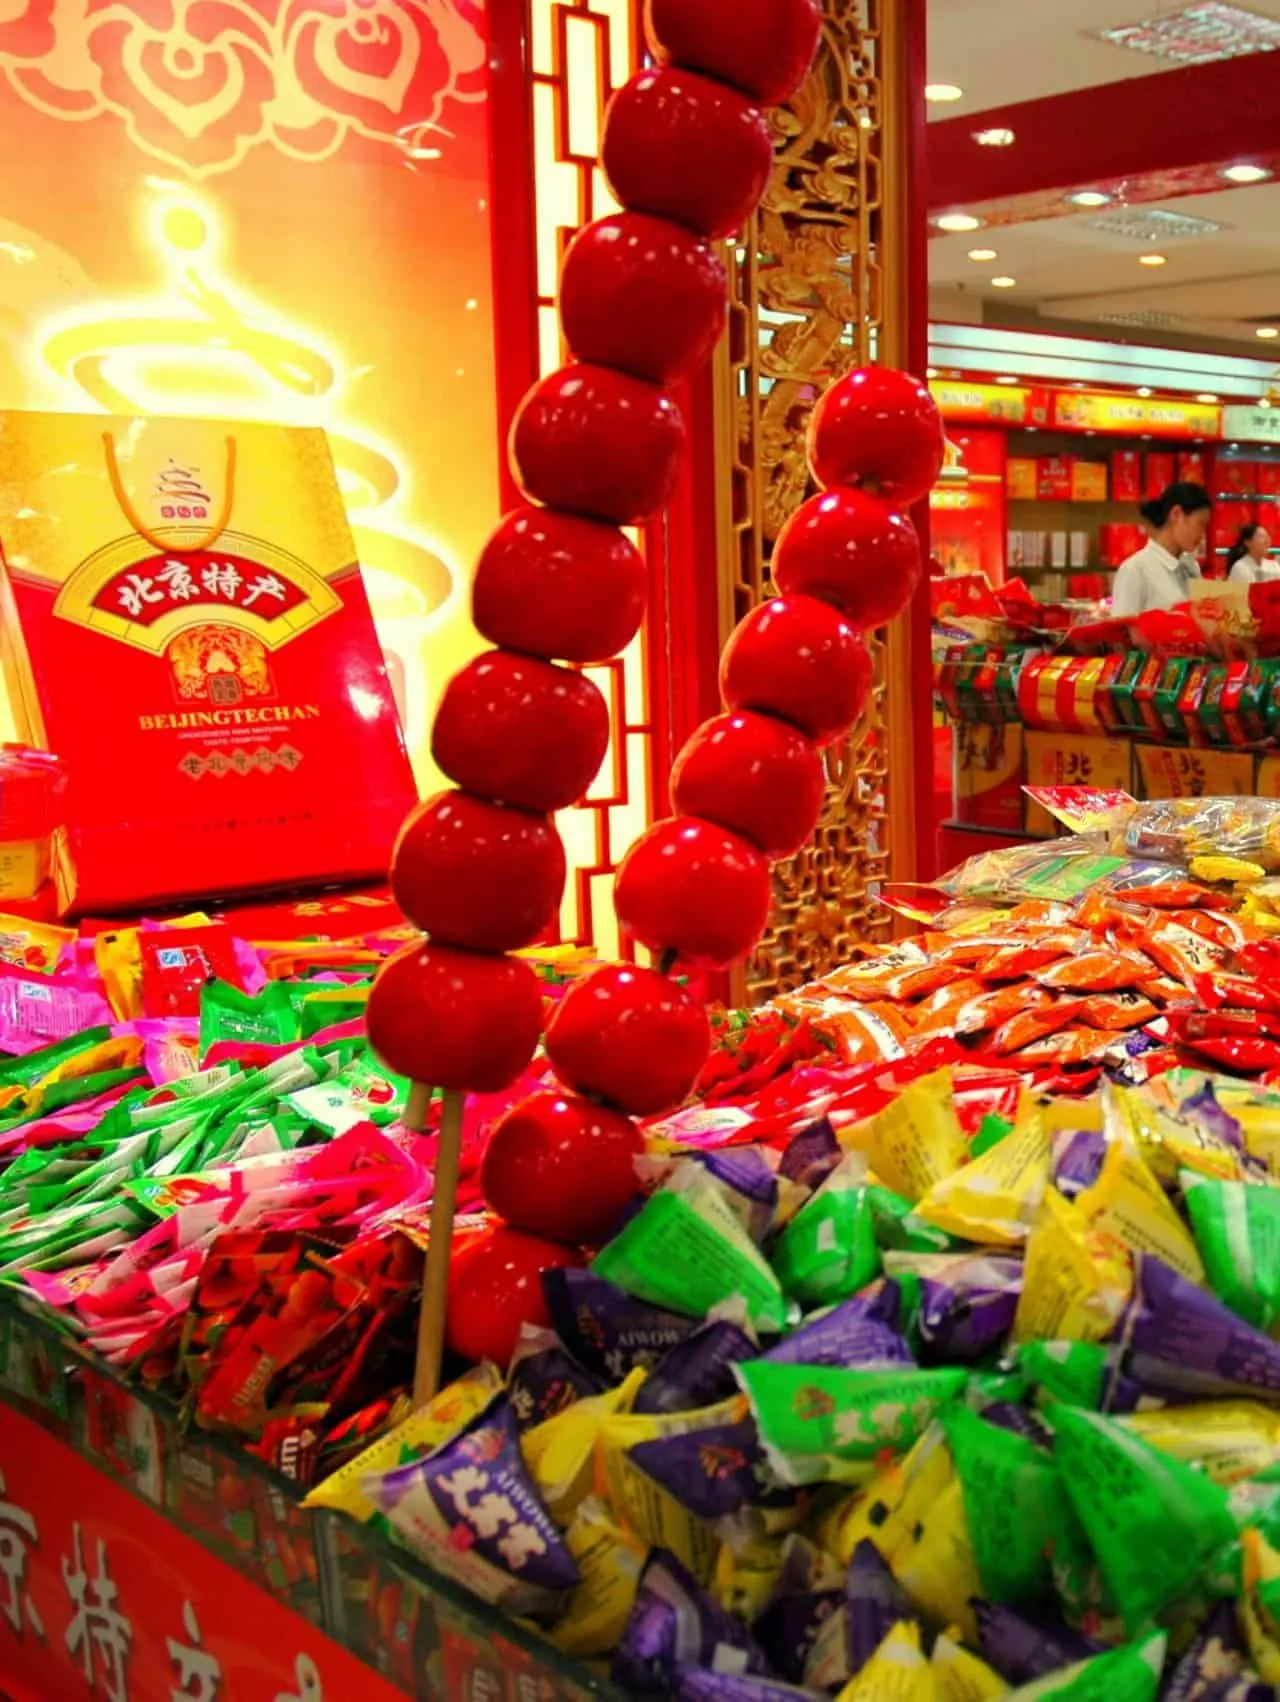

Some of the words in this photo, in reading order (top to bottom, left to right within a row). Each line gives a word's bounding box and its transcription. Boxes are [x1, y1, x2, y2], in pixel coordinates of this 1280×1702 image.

[118, 560, 286, 616] 北京特产
[139, 704, 320, 730] BEIJINGTECHAN
[616, 1328, 684, 1346] AIWOW
